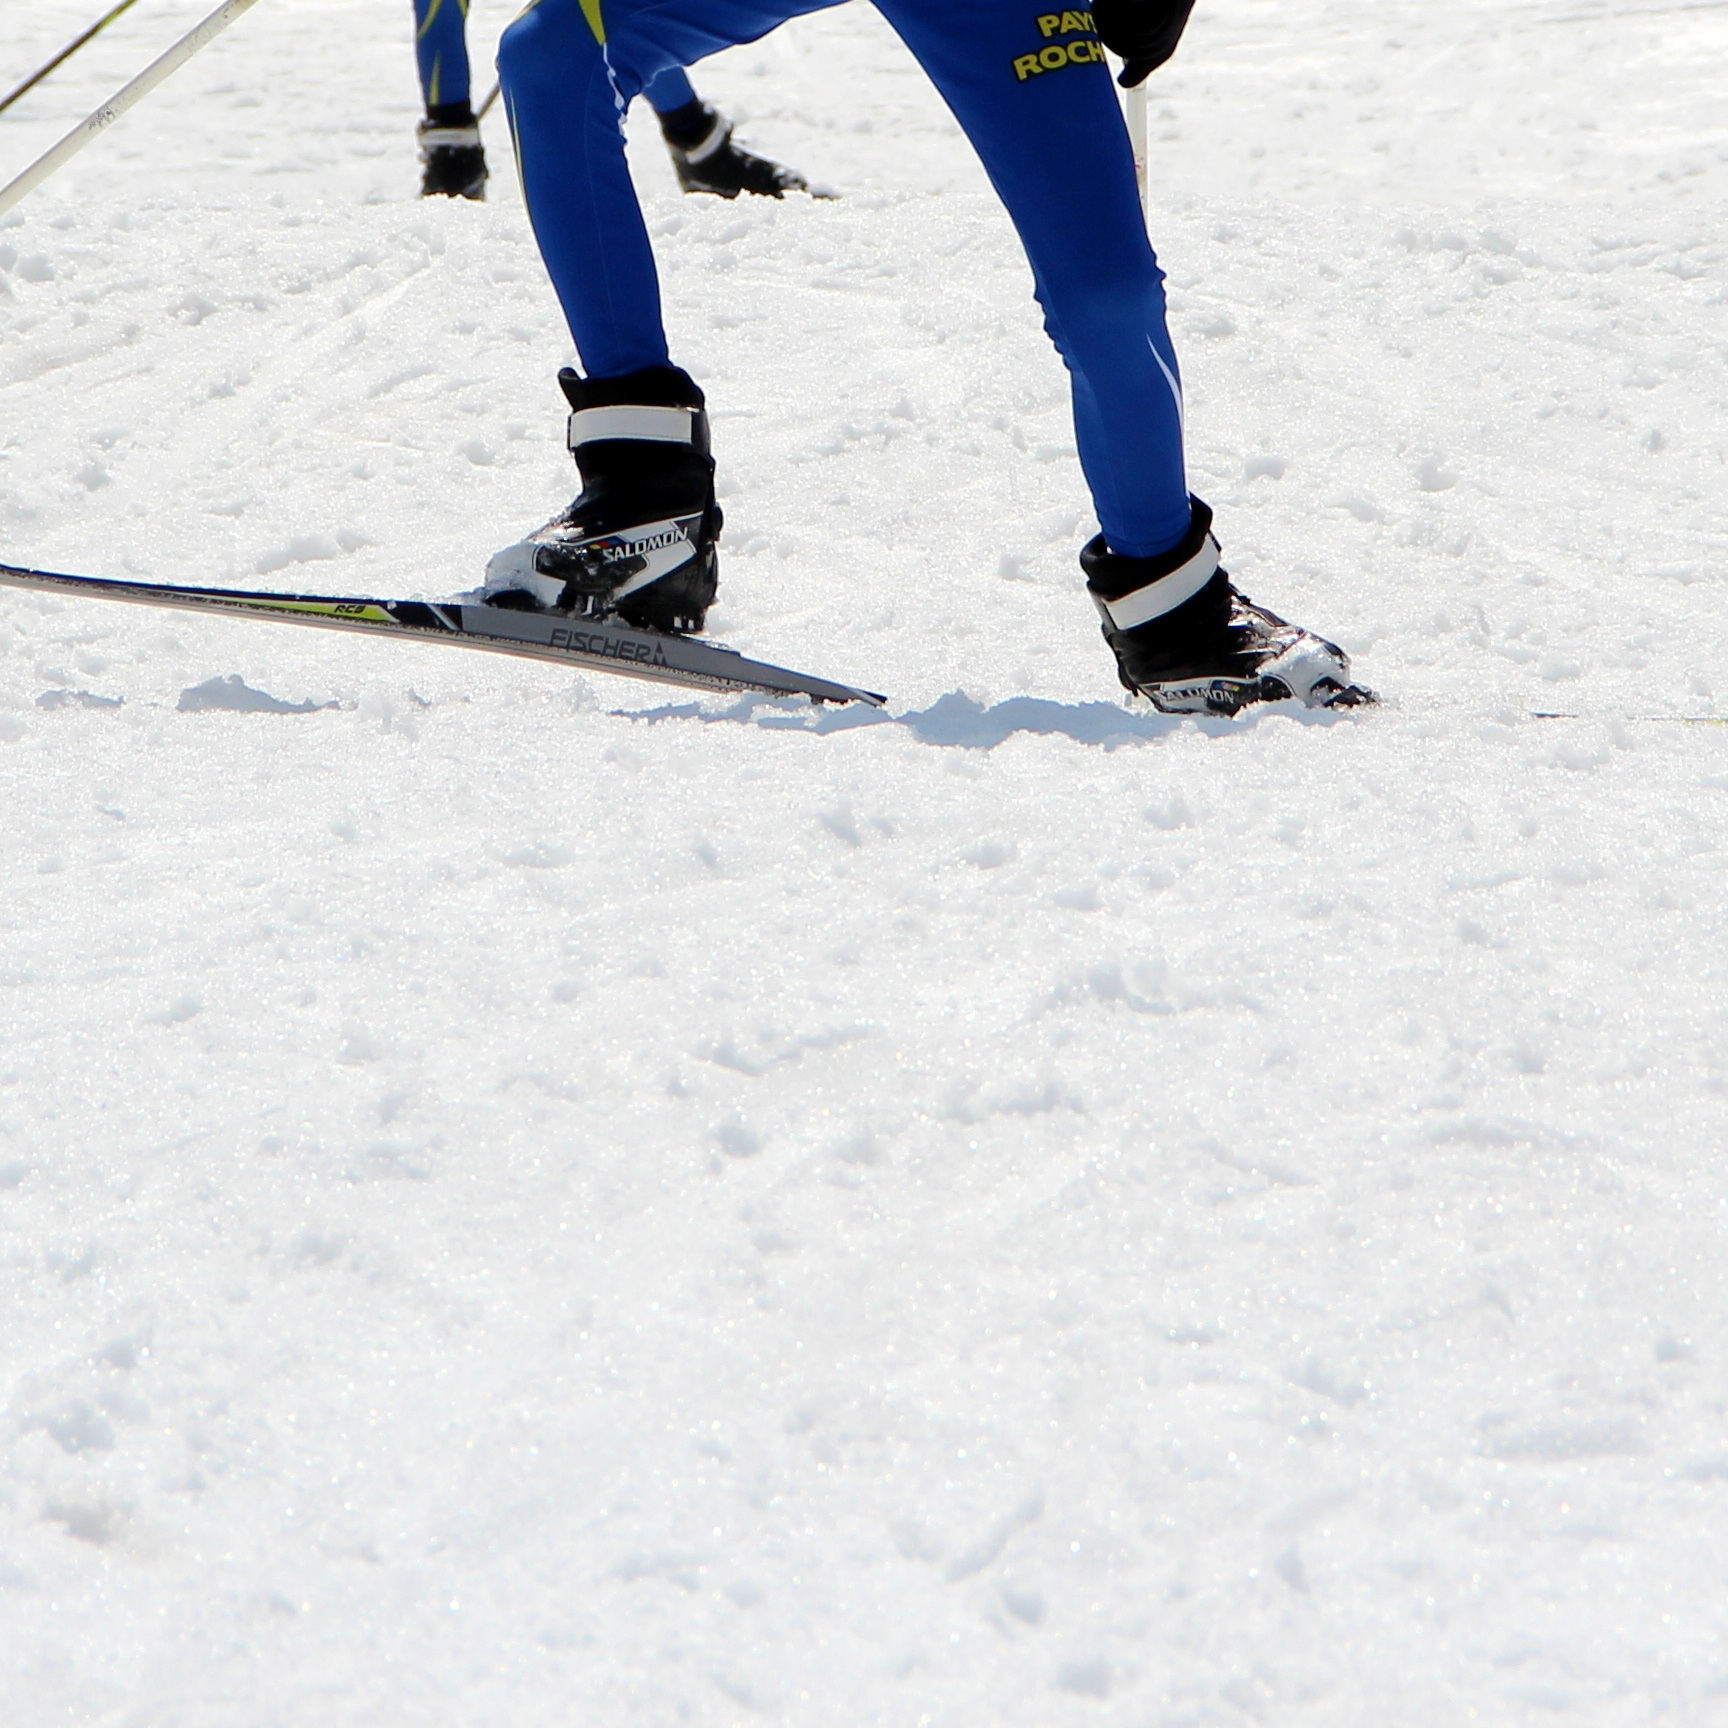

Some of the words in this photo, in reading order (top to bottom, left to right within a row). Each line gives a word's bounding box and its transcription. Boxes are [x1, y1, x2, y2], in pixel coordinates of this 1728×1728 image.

[1037, 10, 1098, 38] PAY
[603, 526, 688, 563] SALOMON
[550, 627, 651, 664] FISCHER
[1153, 688, 1234, 704] SALOMON
